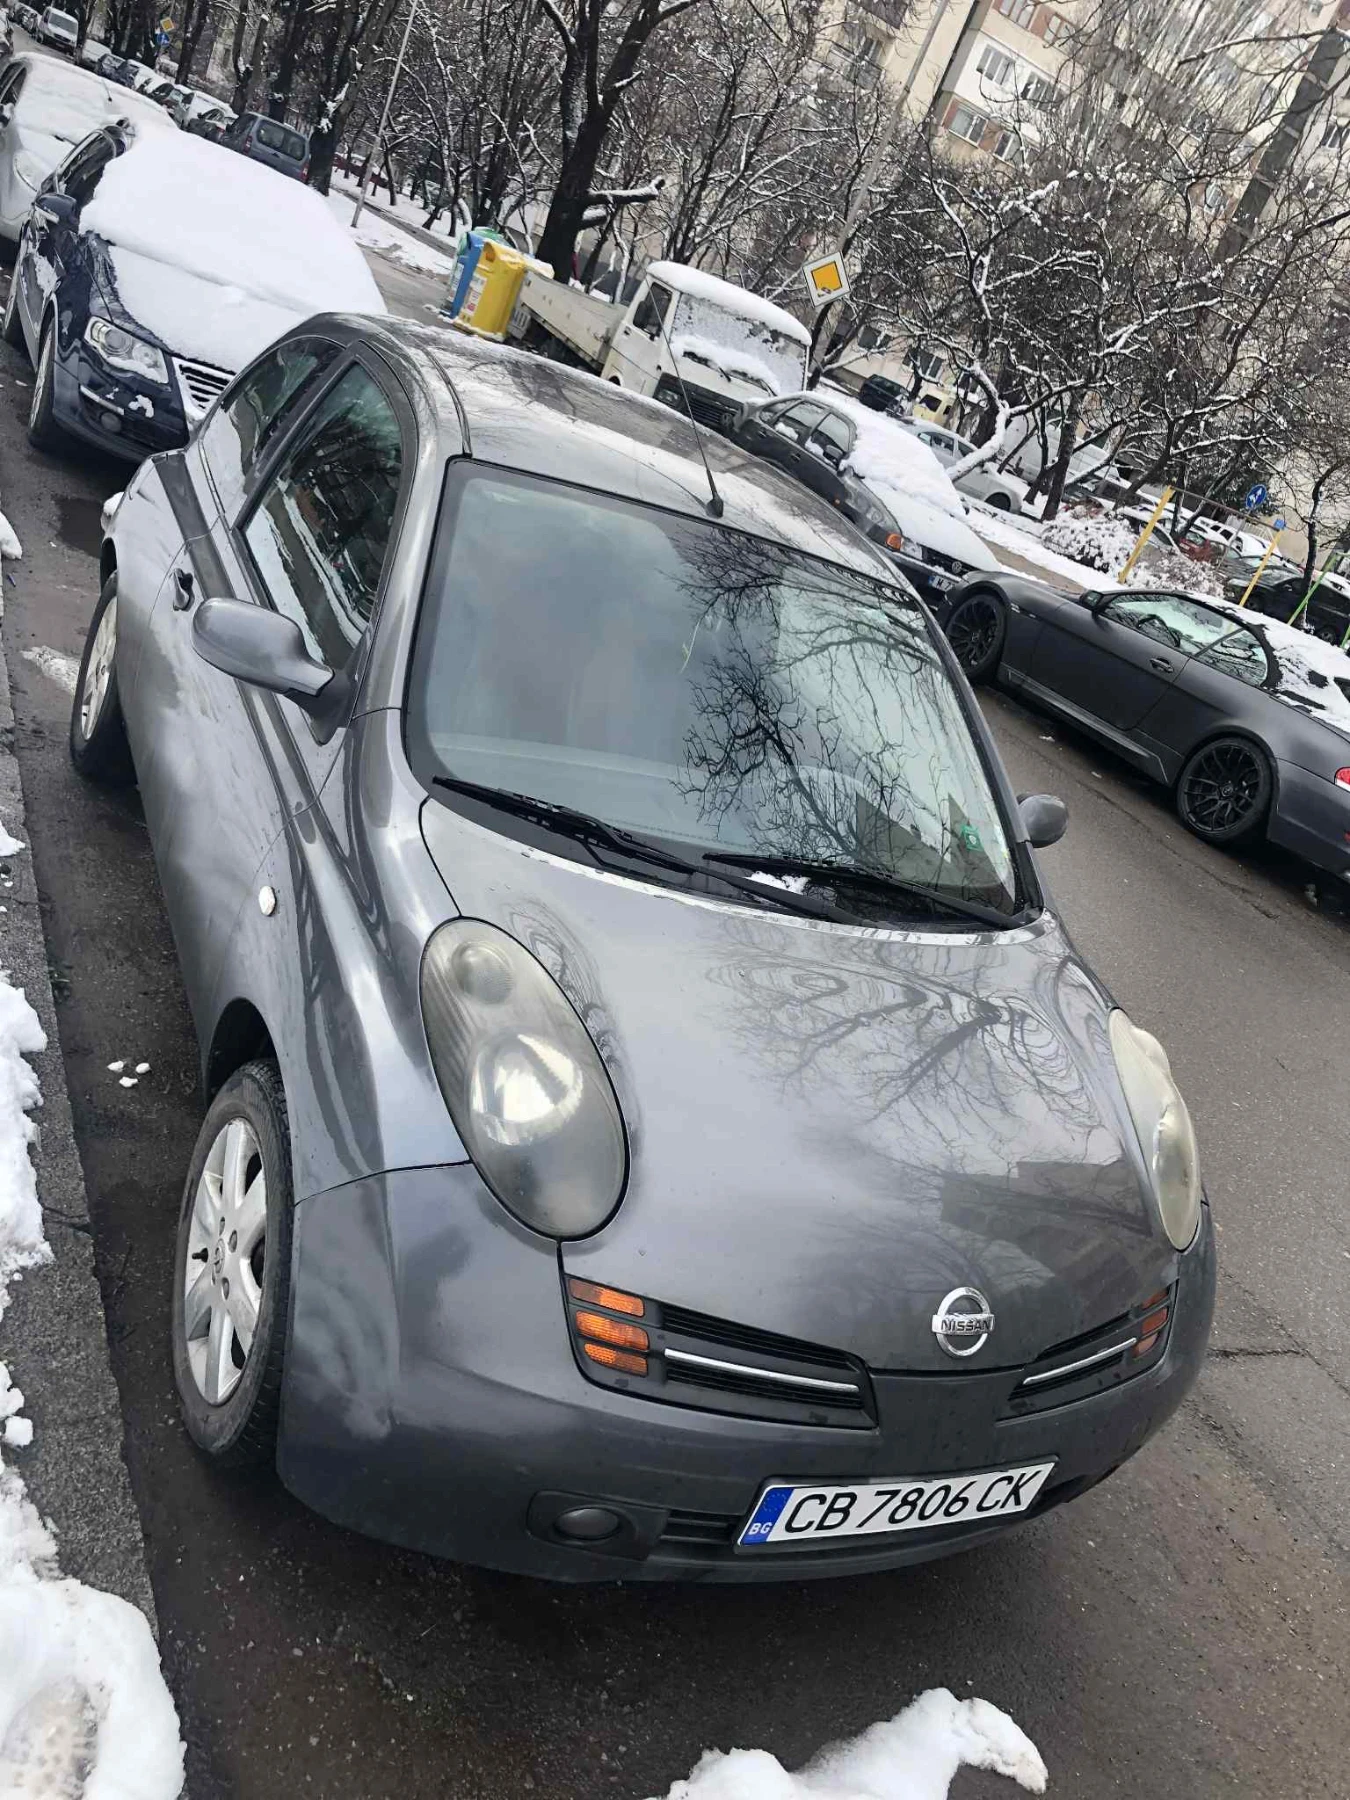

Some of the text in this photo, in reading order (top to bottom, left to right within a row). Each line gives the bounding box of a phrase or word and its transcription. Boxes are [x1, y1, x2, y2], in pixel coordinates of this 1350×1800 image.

[941, 1319, 991, 1332] NISSAN
[784, 1469, 1041, 1534] CB 7806 CK
[748, 1521, 773, 1535] BG
